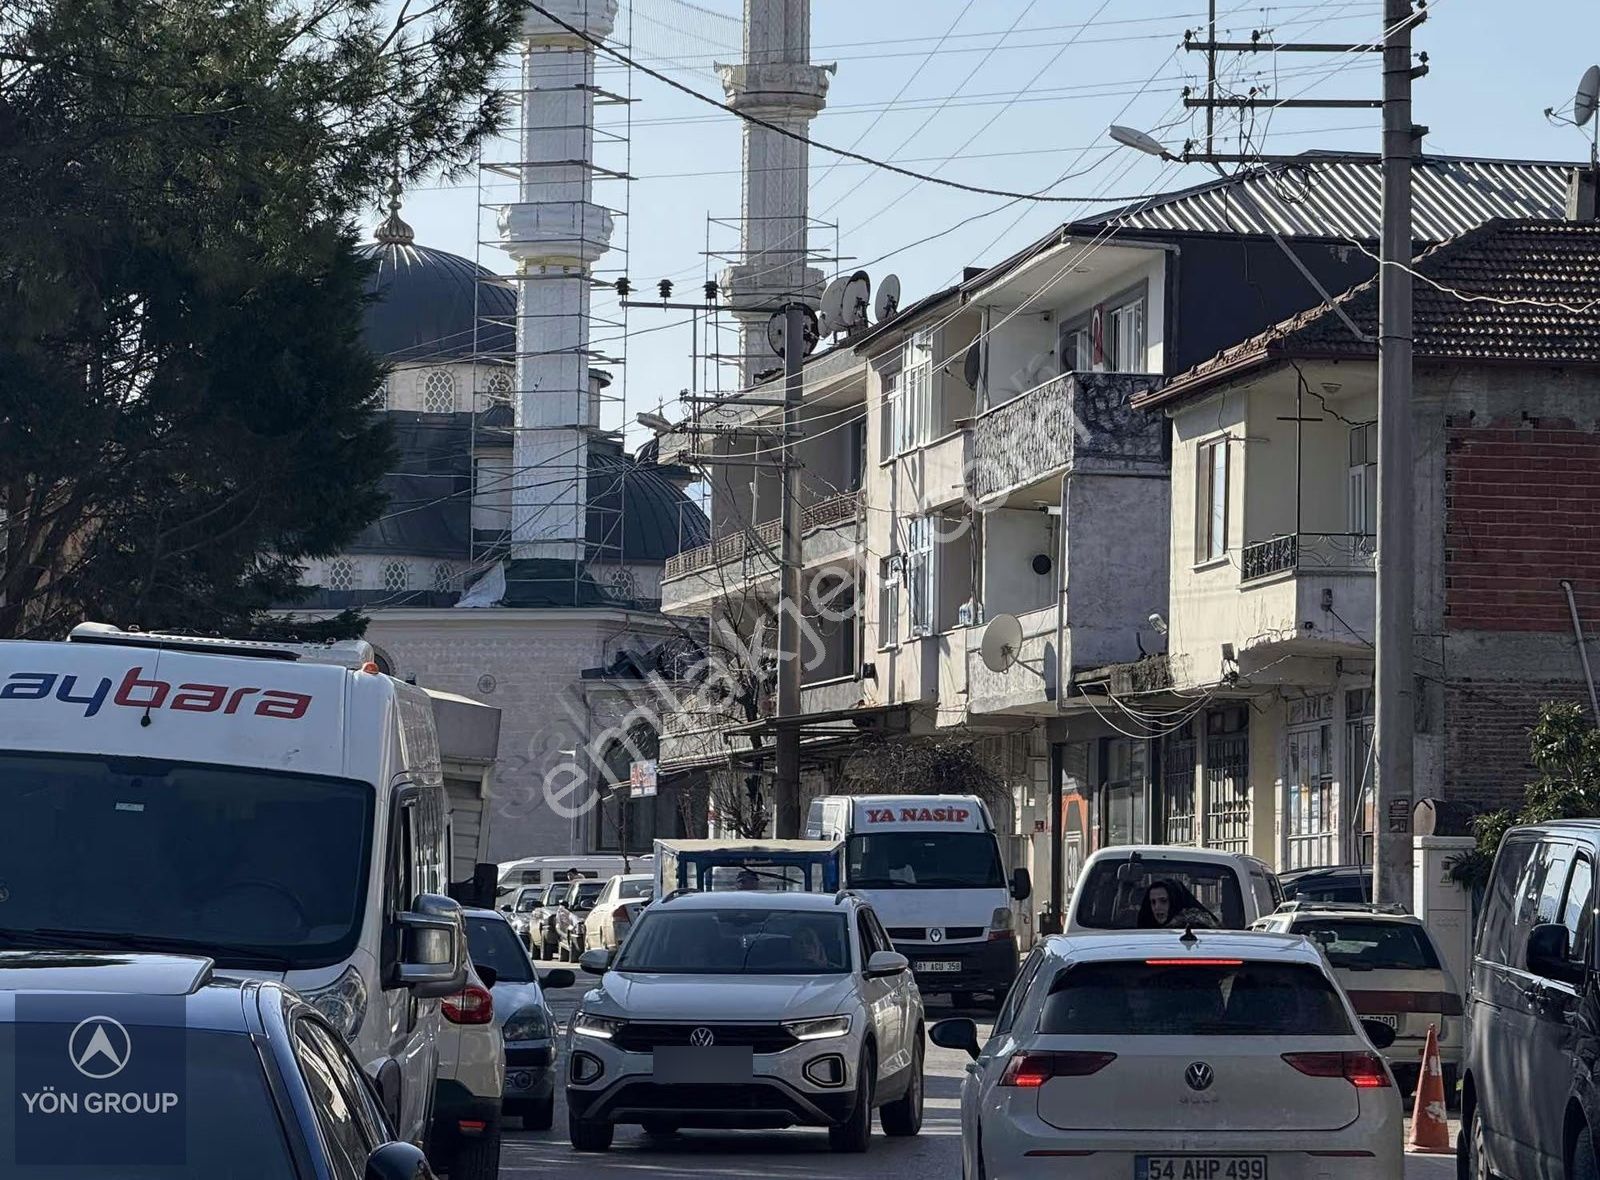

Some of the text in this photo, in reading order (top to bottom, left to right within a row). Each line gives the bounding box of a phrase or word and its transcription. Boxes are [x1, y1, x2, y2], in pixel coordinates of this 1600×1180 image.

[865, 805, 969, 823] YA NASİP
[1150, 1160, 1175, 1180] 54
[1183, 1160, 1220, 1180] AHP
[1226, 1160, 1263, 1180] 499
